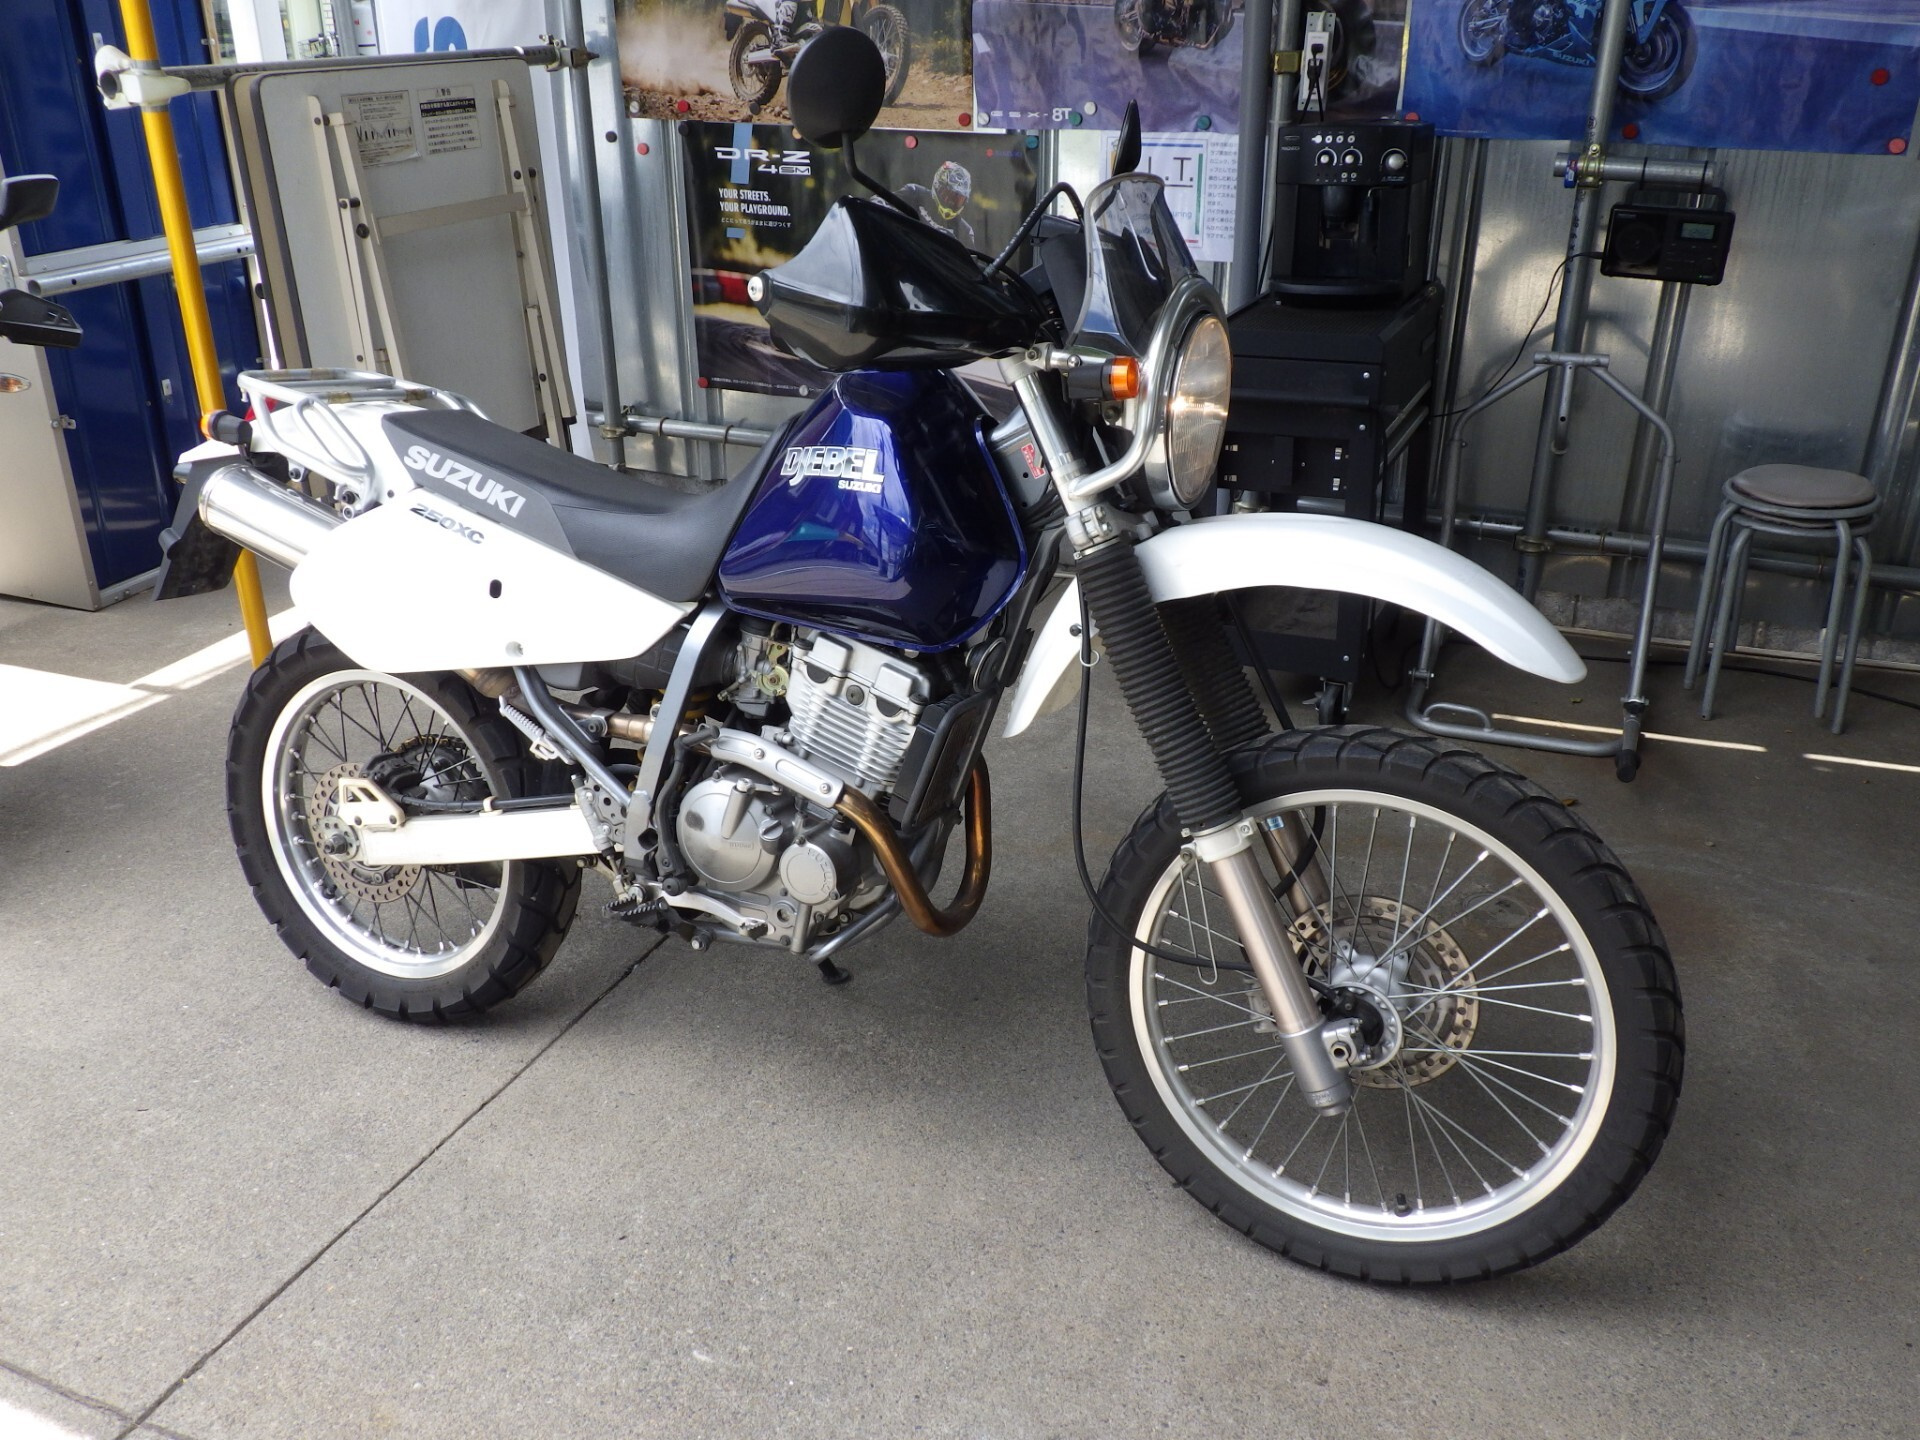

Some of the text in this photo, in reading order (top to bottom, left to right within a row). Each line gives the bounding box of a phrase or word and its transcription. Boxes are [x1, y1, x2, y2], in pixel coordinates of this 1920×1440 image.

[714, 146, 811, 163] DR-Z
[718, 188, 771, 202] YOUR STREETS.
[719, 201, 791, 217] YOUR PLAYGROUND.
[780, 446, 885, 487] DJEBEL
[403, 444, 527, 518] SUZUKI
[837, 479, 882, 494] SUZUKI
[409, 502, 485, 544] 250XC
